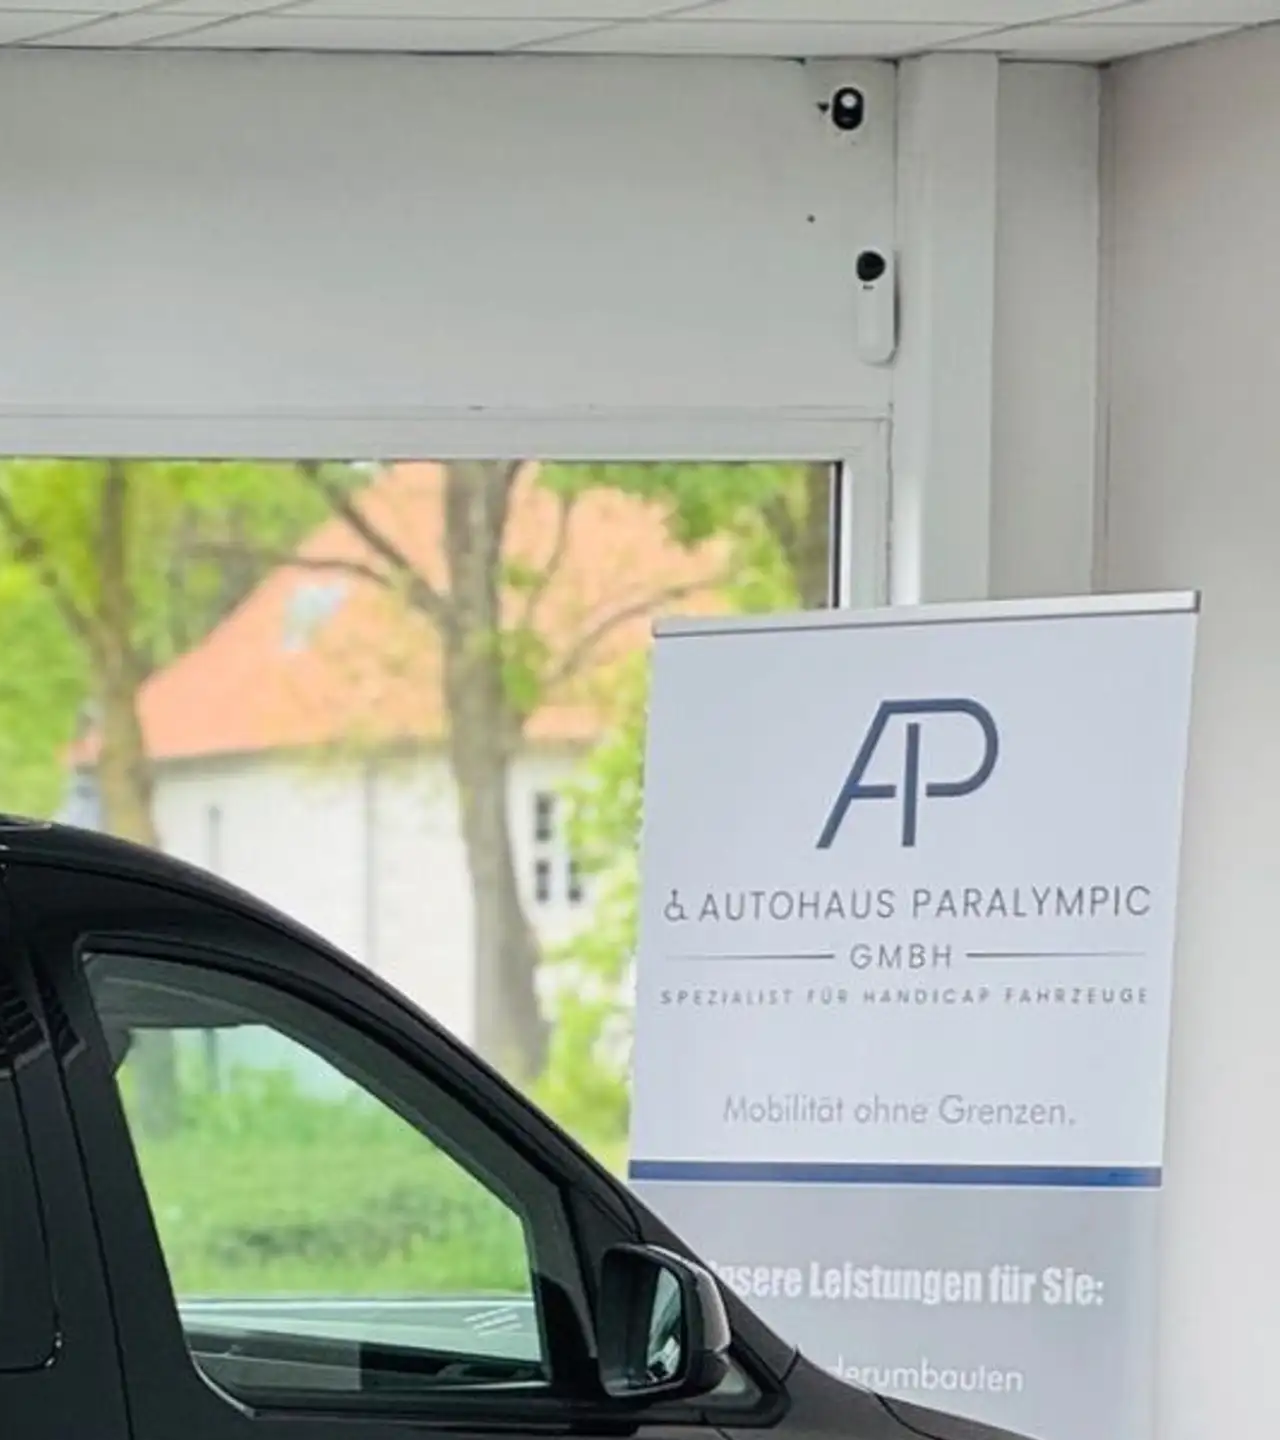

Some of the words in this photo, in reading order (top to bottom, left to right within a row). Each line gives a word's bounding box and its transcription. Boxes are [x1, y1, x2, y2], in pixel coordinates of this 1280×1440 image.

[698, 889, 895, 922] AUTOHAUS
[913, 885, 1152, 919] PARALYMPIC
[849, 943, 954, 969] GMBH
[660, 989, 793, 1006] SPEZIALIST
[806, 987, 849, 1006] FÜR
[863, 988, 991, 1006] HANDICAP
[1004, 987, 1149, 1005] FAHRZEUGE
[723, 1093, 844, 1125] Mobilität
[854, 1094, 929, 1124] ohne
[938, 1096, 1078, 1127] Grenzen.
[707, 1260, 803, 1298] nsere
[809, 1260, 984, 1306] Leistungen
[988, 1264, 1038, 1304] für
[1042, 1267, 1104, 1306] Sie:
